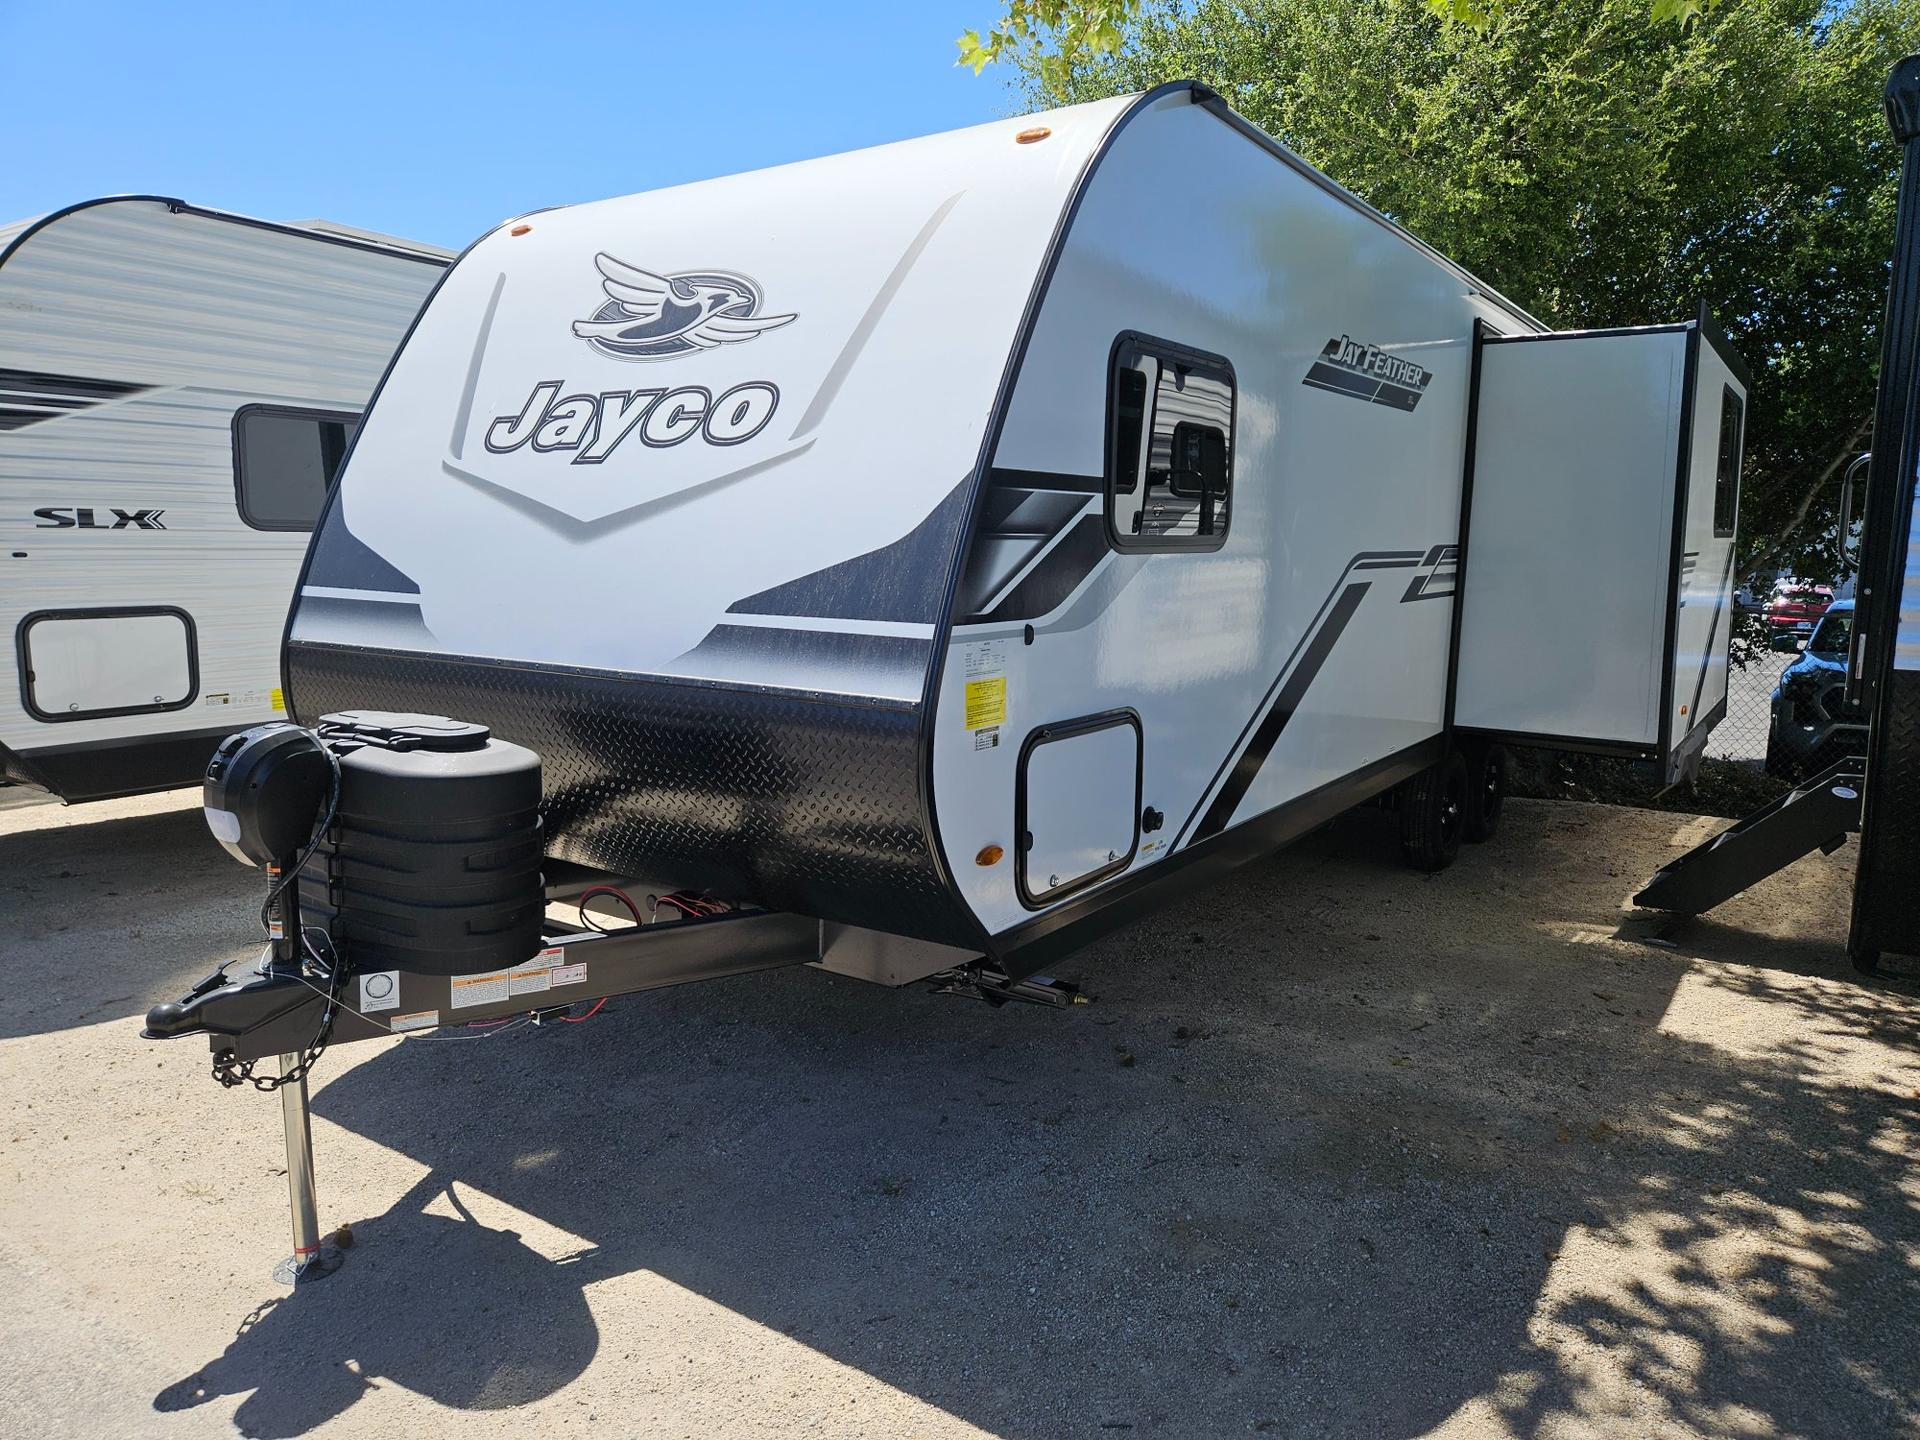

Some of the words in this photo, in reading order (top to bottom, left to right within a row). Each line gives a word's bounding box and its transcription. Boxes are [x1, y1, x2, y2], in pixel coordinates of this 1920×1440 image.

[1329, 334, 1364, 366] JAY
[1362, 344, 1424, 386] FEATHER
[484, 380, 780, 465] Jayco
[33, 507, 167, 529] SLX
